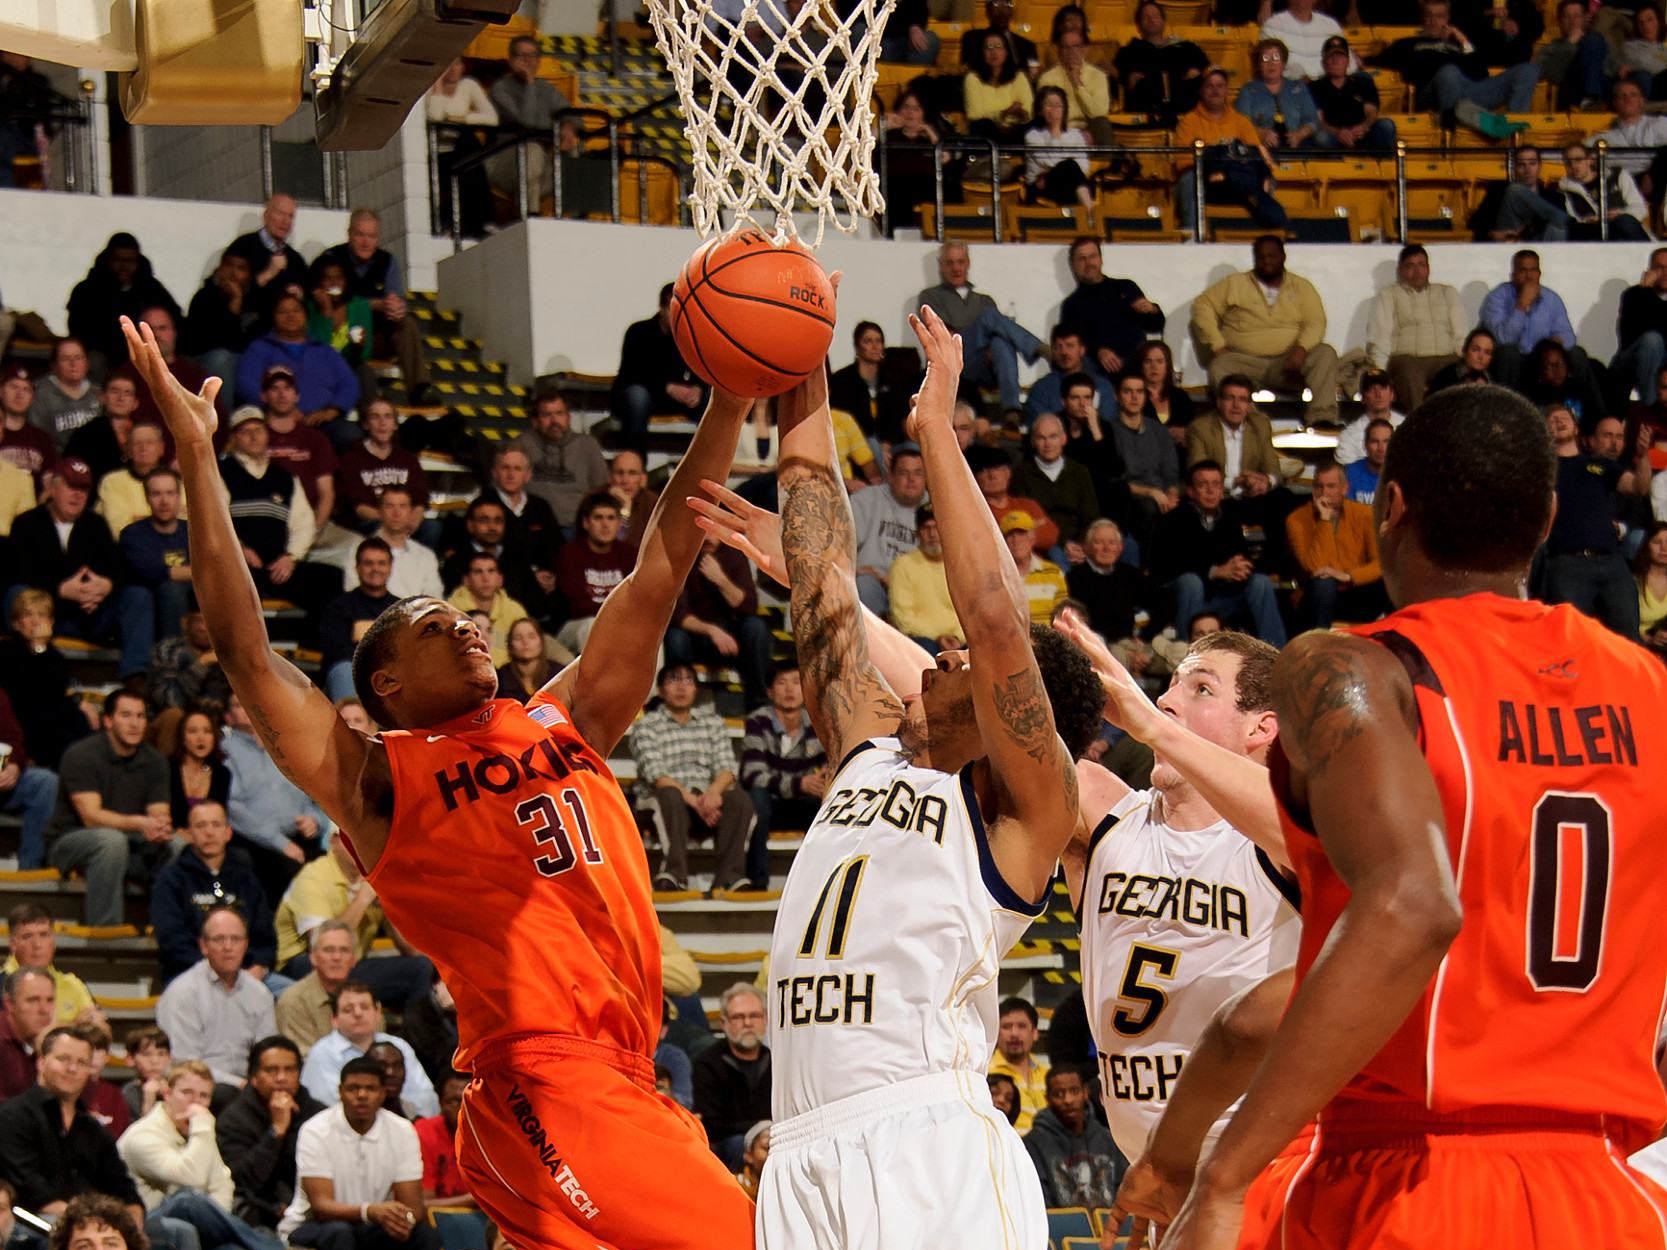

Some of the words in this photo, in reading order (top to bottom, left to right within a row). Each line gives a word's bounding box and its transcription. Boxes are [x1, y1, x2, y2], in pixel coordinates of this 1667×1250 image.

[790, 286, 825, 309] ROCK
[1497, 700, 1638, 767] ALLEN
[514, 788, 604, 877] 31
[796, 854, 870, 960] 11
[1525, 789, 1614, 993] 0
[777, 973, 876, 1031] TECH
[1110, 941, 1182, 1038] 5
